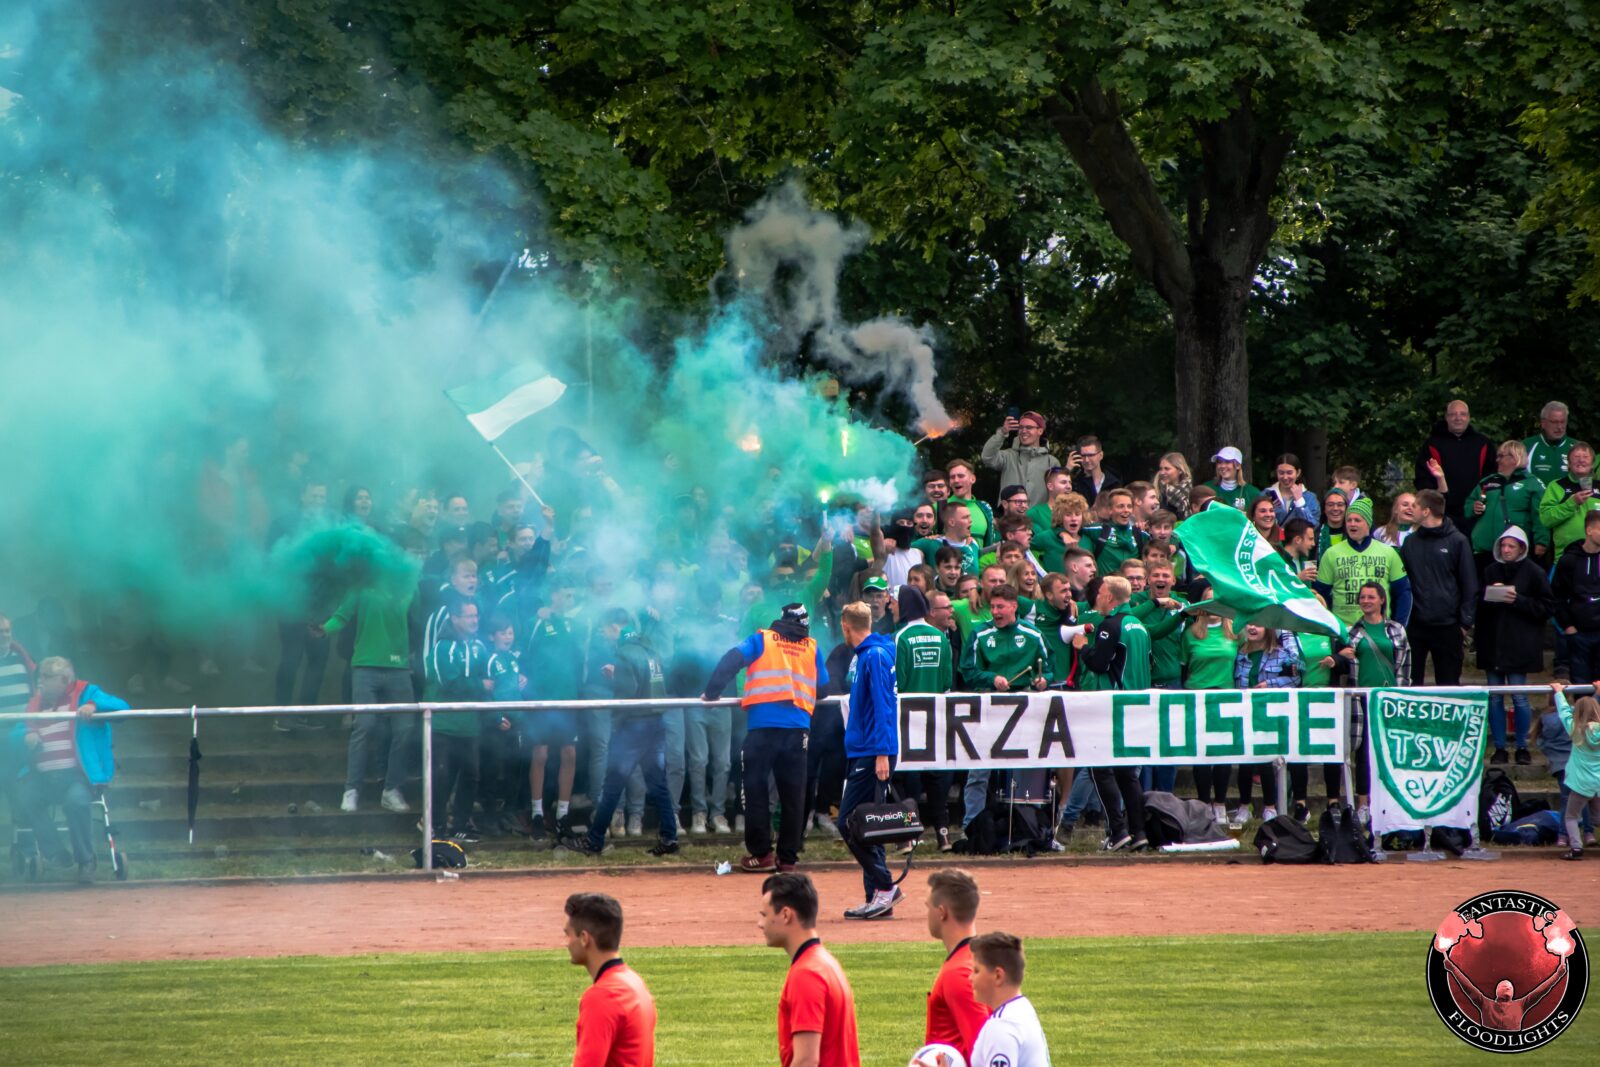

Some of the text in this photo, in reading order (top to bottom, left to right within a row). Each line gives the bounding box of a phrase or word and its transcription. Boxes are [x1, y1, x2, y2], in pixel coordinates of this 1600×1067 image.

[1336, 555, 1386, 567] CAMP DAVID
[900, 691, 1336, 762] ORZA COSSE
[1383, 699, 1467, 722] DRESDEN
[1387, 728, 1459, 768] TSV
[1439, 704, 1486, 796] COSSEBAUDE
